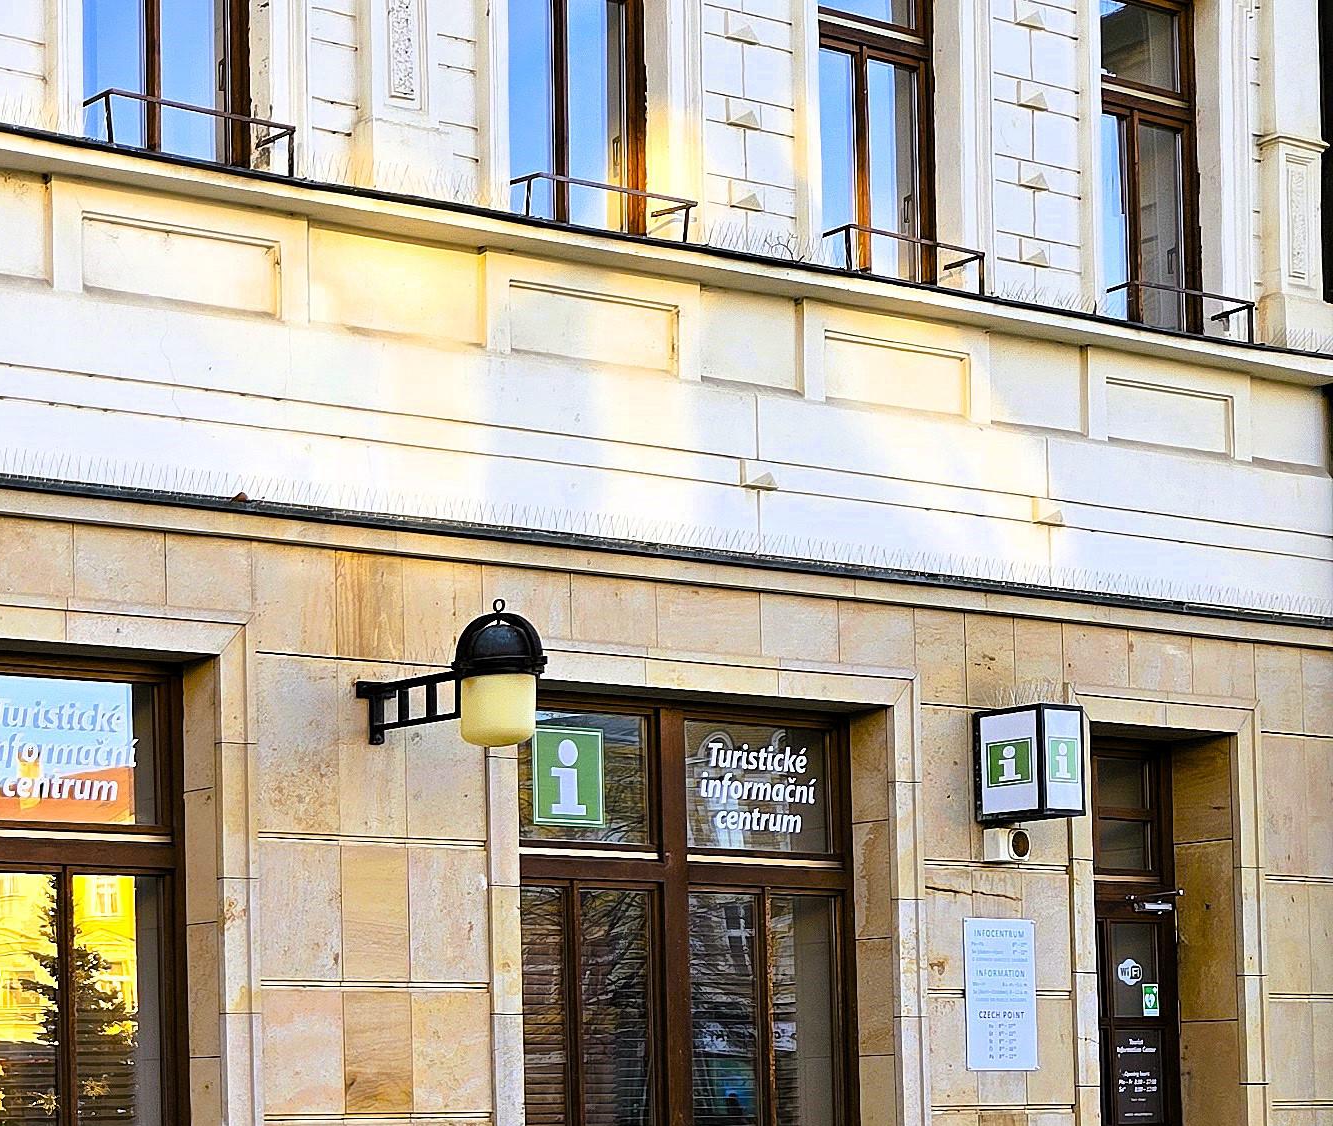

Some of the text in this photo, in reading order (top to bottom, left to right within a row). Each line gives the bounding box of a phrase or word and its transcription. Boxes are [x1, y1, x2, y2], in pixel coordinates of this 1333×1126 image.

[707, 742, 807, 774] Turistické
[1, 773, 119, 802] centrum
[700, 773, 816, 804] informační
[715, 807, 802, 834] centrum
[973, 930, 1025, 938] INFOCENTRUM
[979, 1010, 1025, 1019] CZECH POINT
